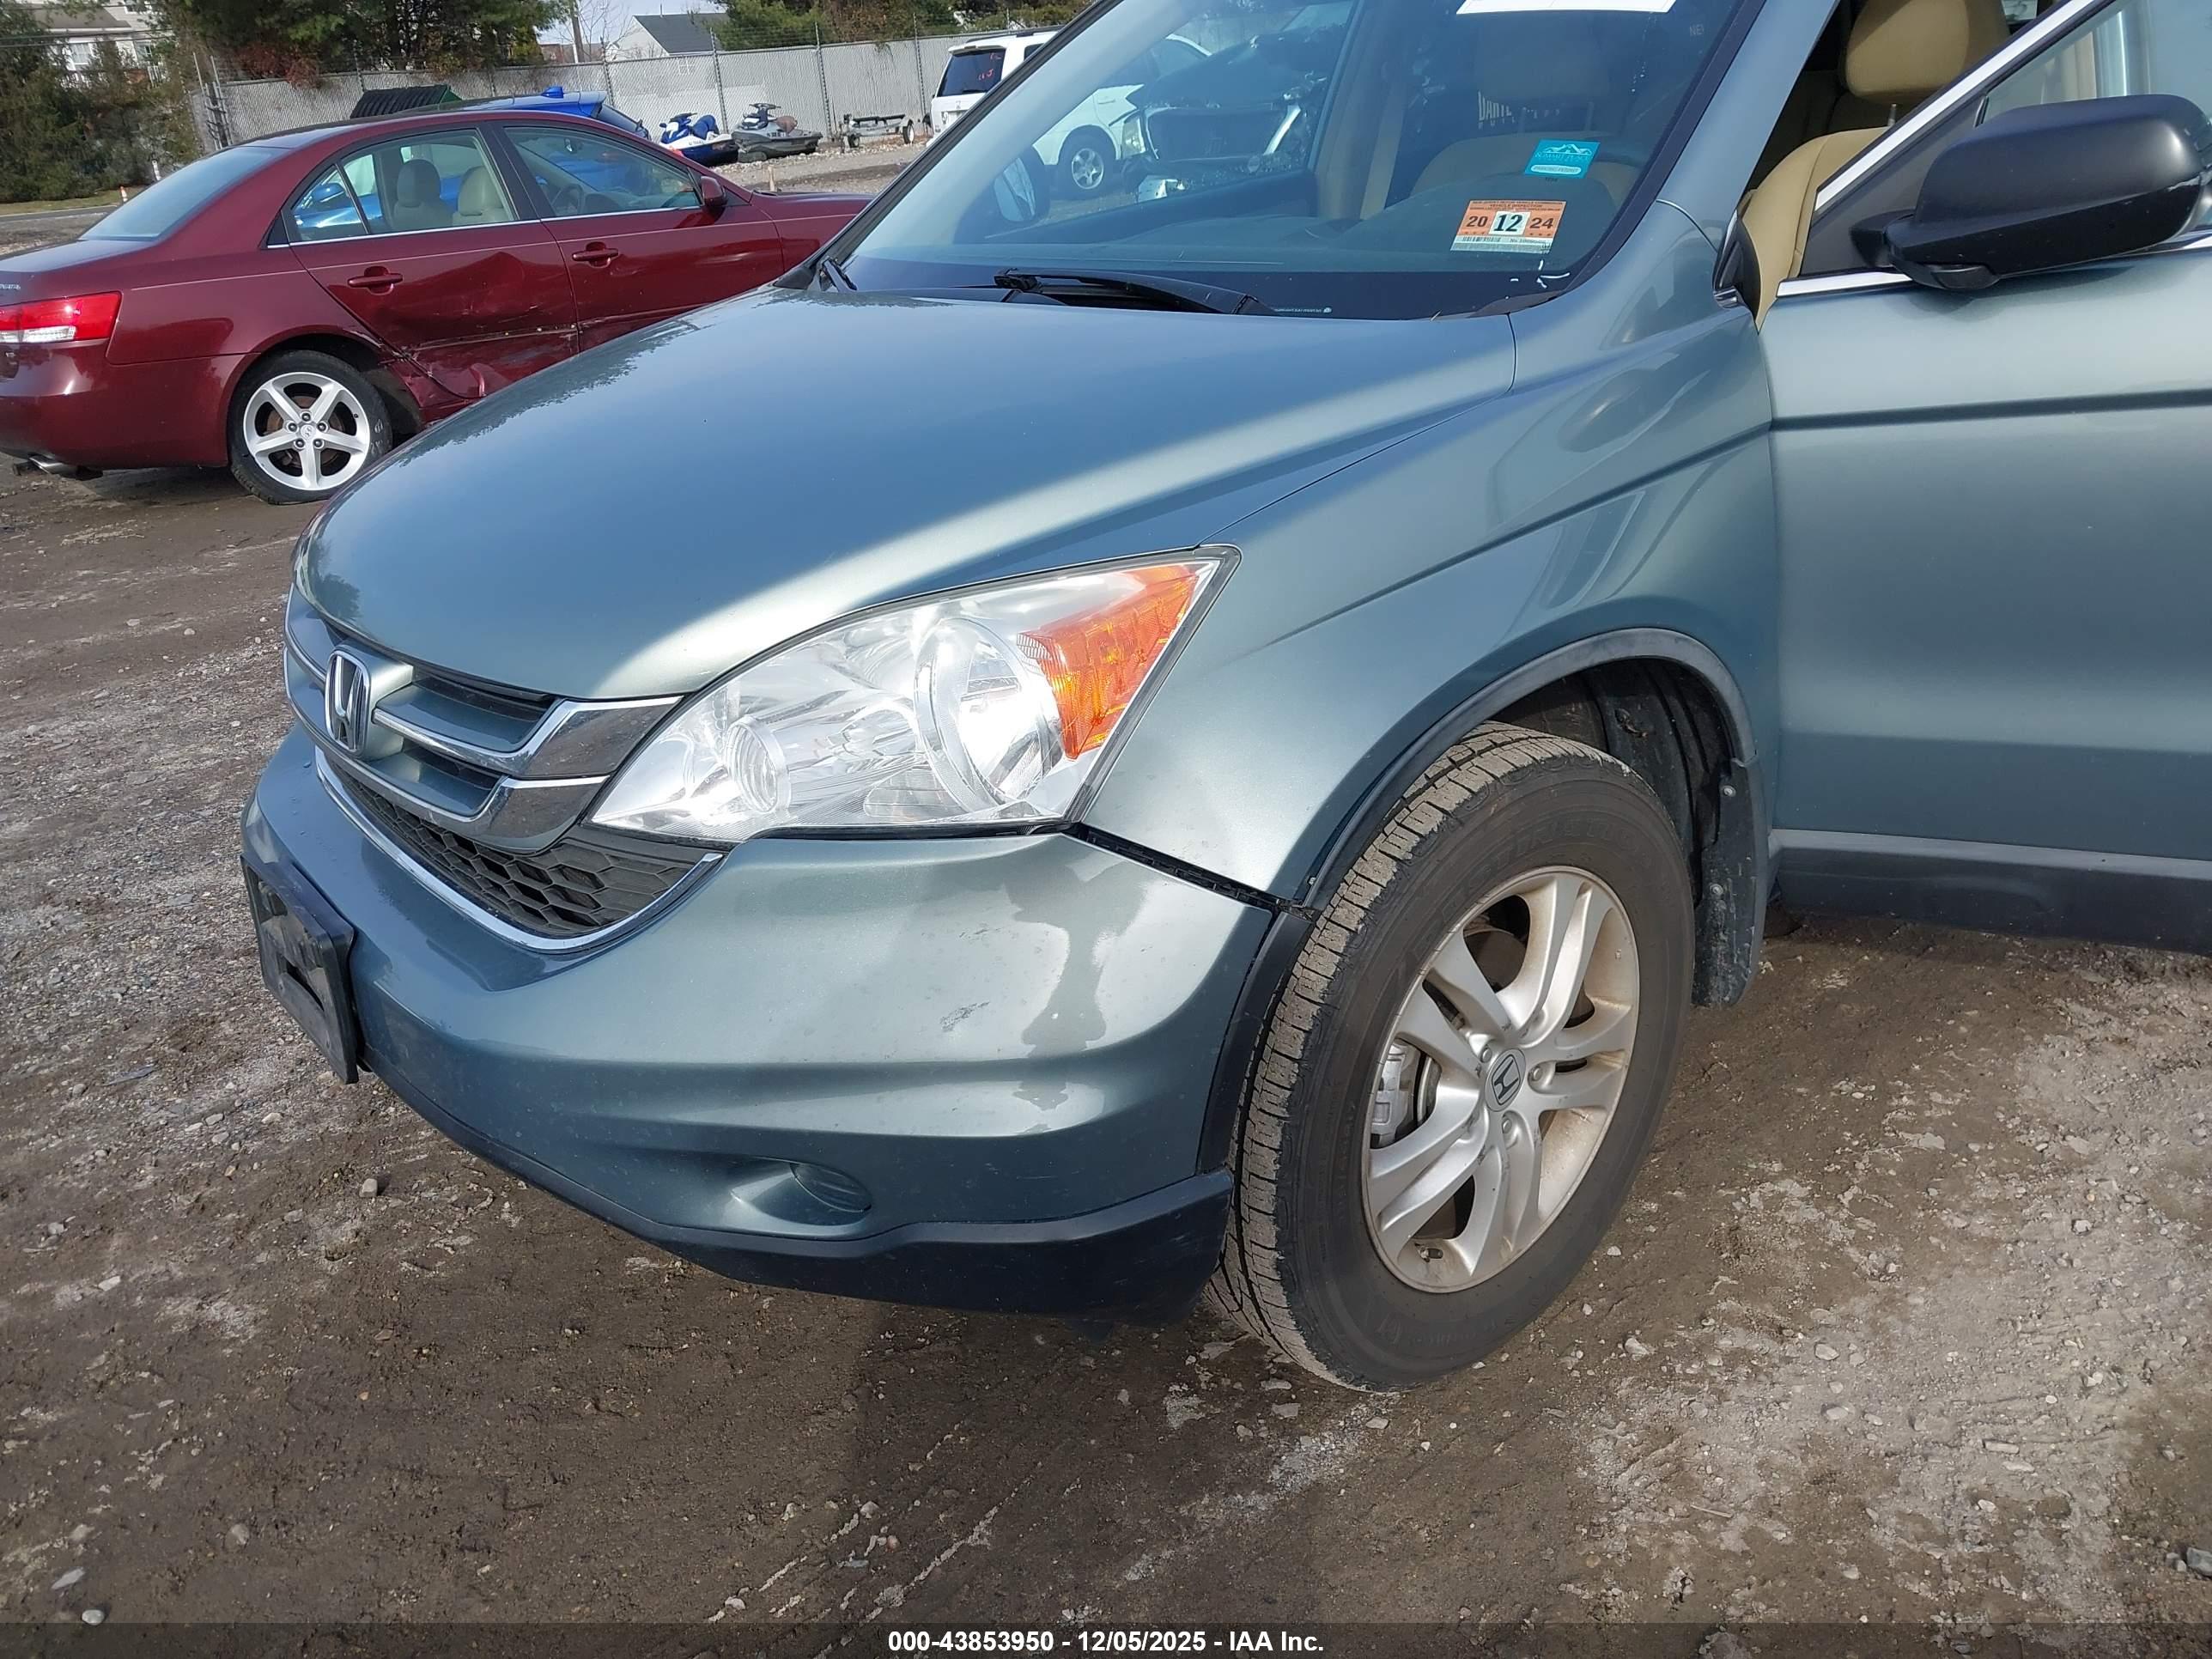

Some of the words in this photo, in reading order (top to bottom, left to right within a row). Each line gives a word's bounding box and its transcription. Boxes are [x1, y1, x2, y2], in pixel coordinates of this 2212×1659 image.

[1466, 215, 1488, 228] 20
[1493, 214, 1523, 232] 12
[1529, 216, 1554, 229] 24
